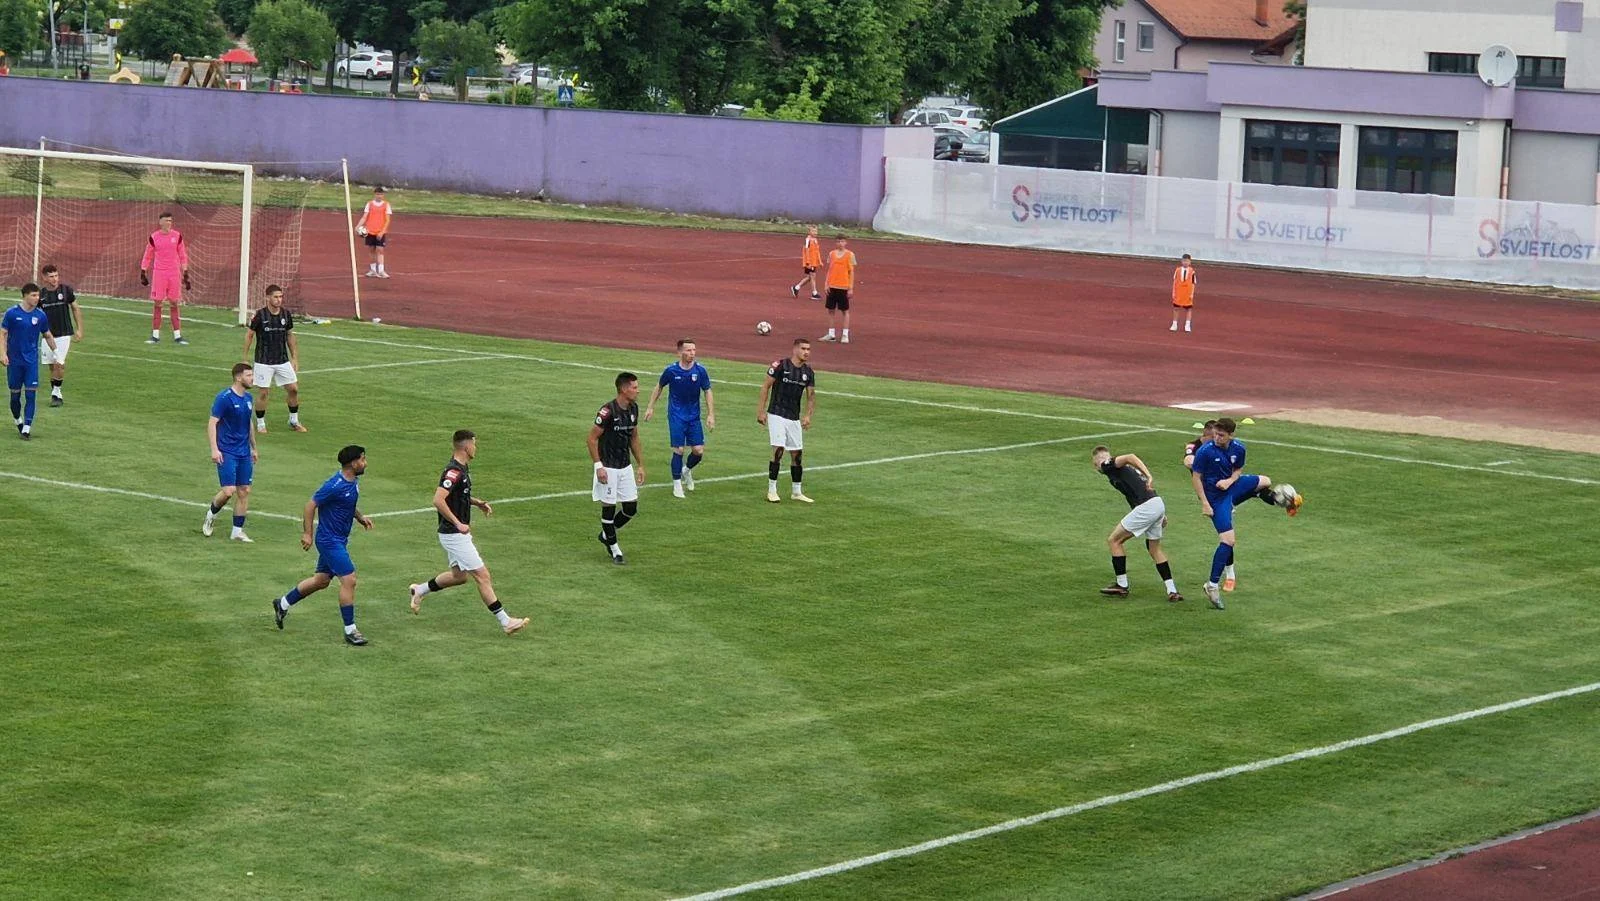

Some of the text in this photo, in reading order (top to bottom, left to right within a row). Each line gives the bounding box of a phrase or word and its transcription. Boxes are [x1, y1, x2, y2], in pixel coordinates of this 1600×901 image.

[1032, 203, 1118, 223] SVJETLOST
[1257, 220, 1347, 242] SVJETLOST
[1499, 238, 1595, 260] SVJETLOST
